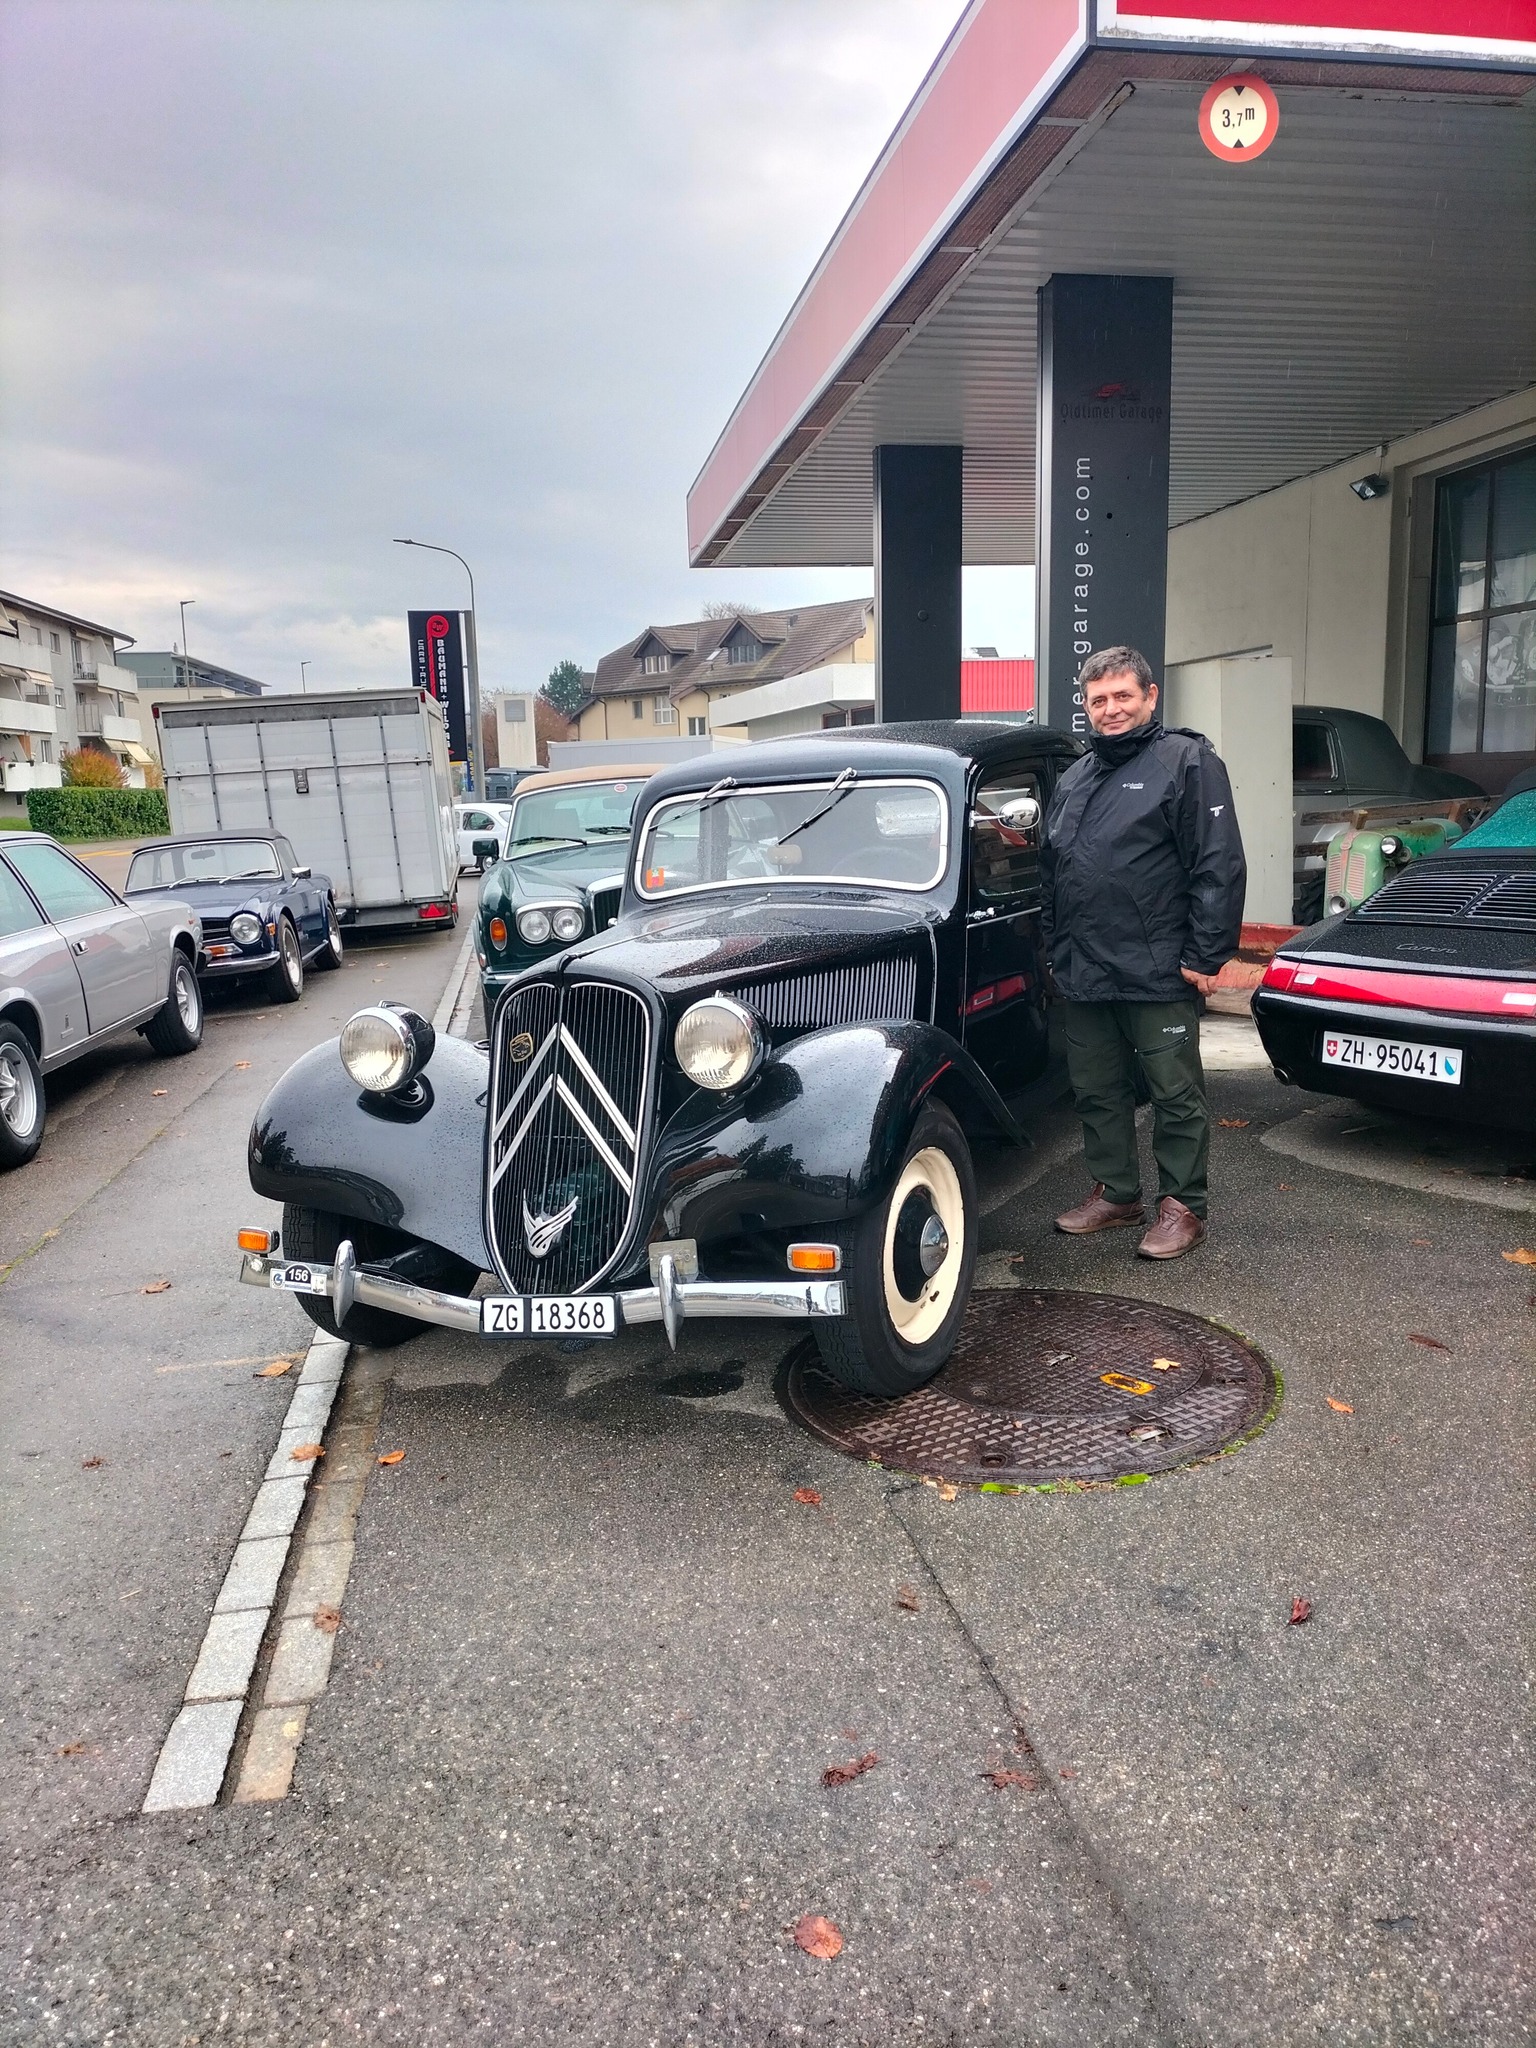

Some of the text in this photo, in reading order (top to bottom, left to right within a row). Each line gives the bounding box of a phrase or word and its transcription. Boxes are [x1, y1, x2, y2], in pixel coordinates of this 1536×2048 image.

[1061, 403, 1163, 423] Oldtimer Garage
[437, 639, 448, 693] BAUMANN
[1395, 943, 1458, 954] Carrera
[288, 1268, 309, 1282] 156
[491, 1301, 606, 1332] ZG 18368
